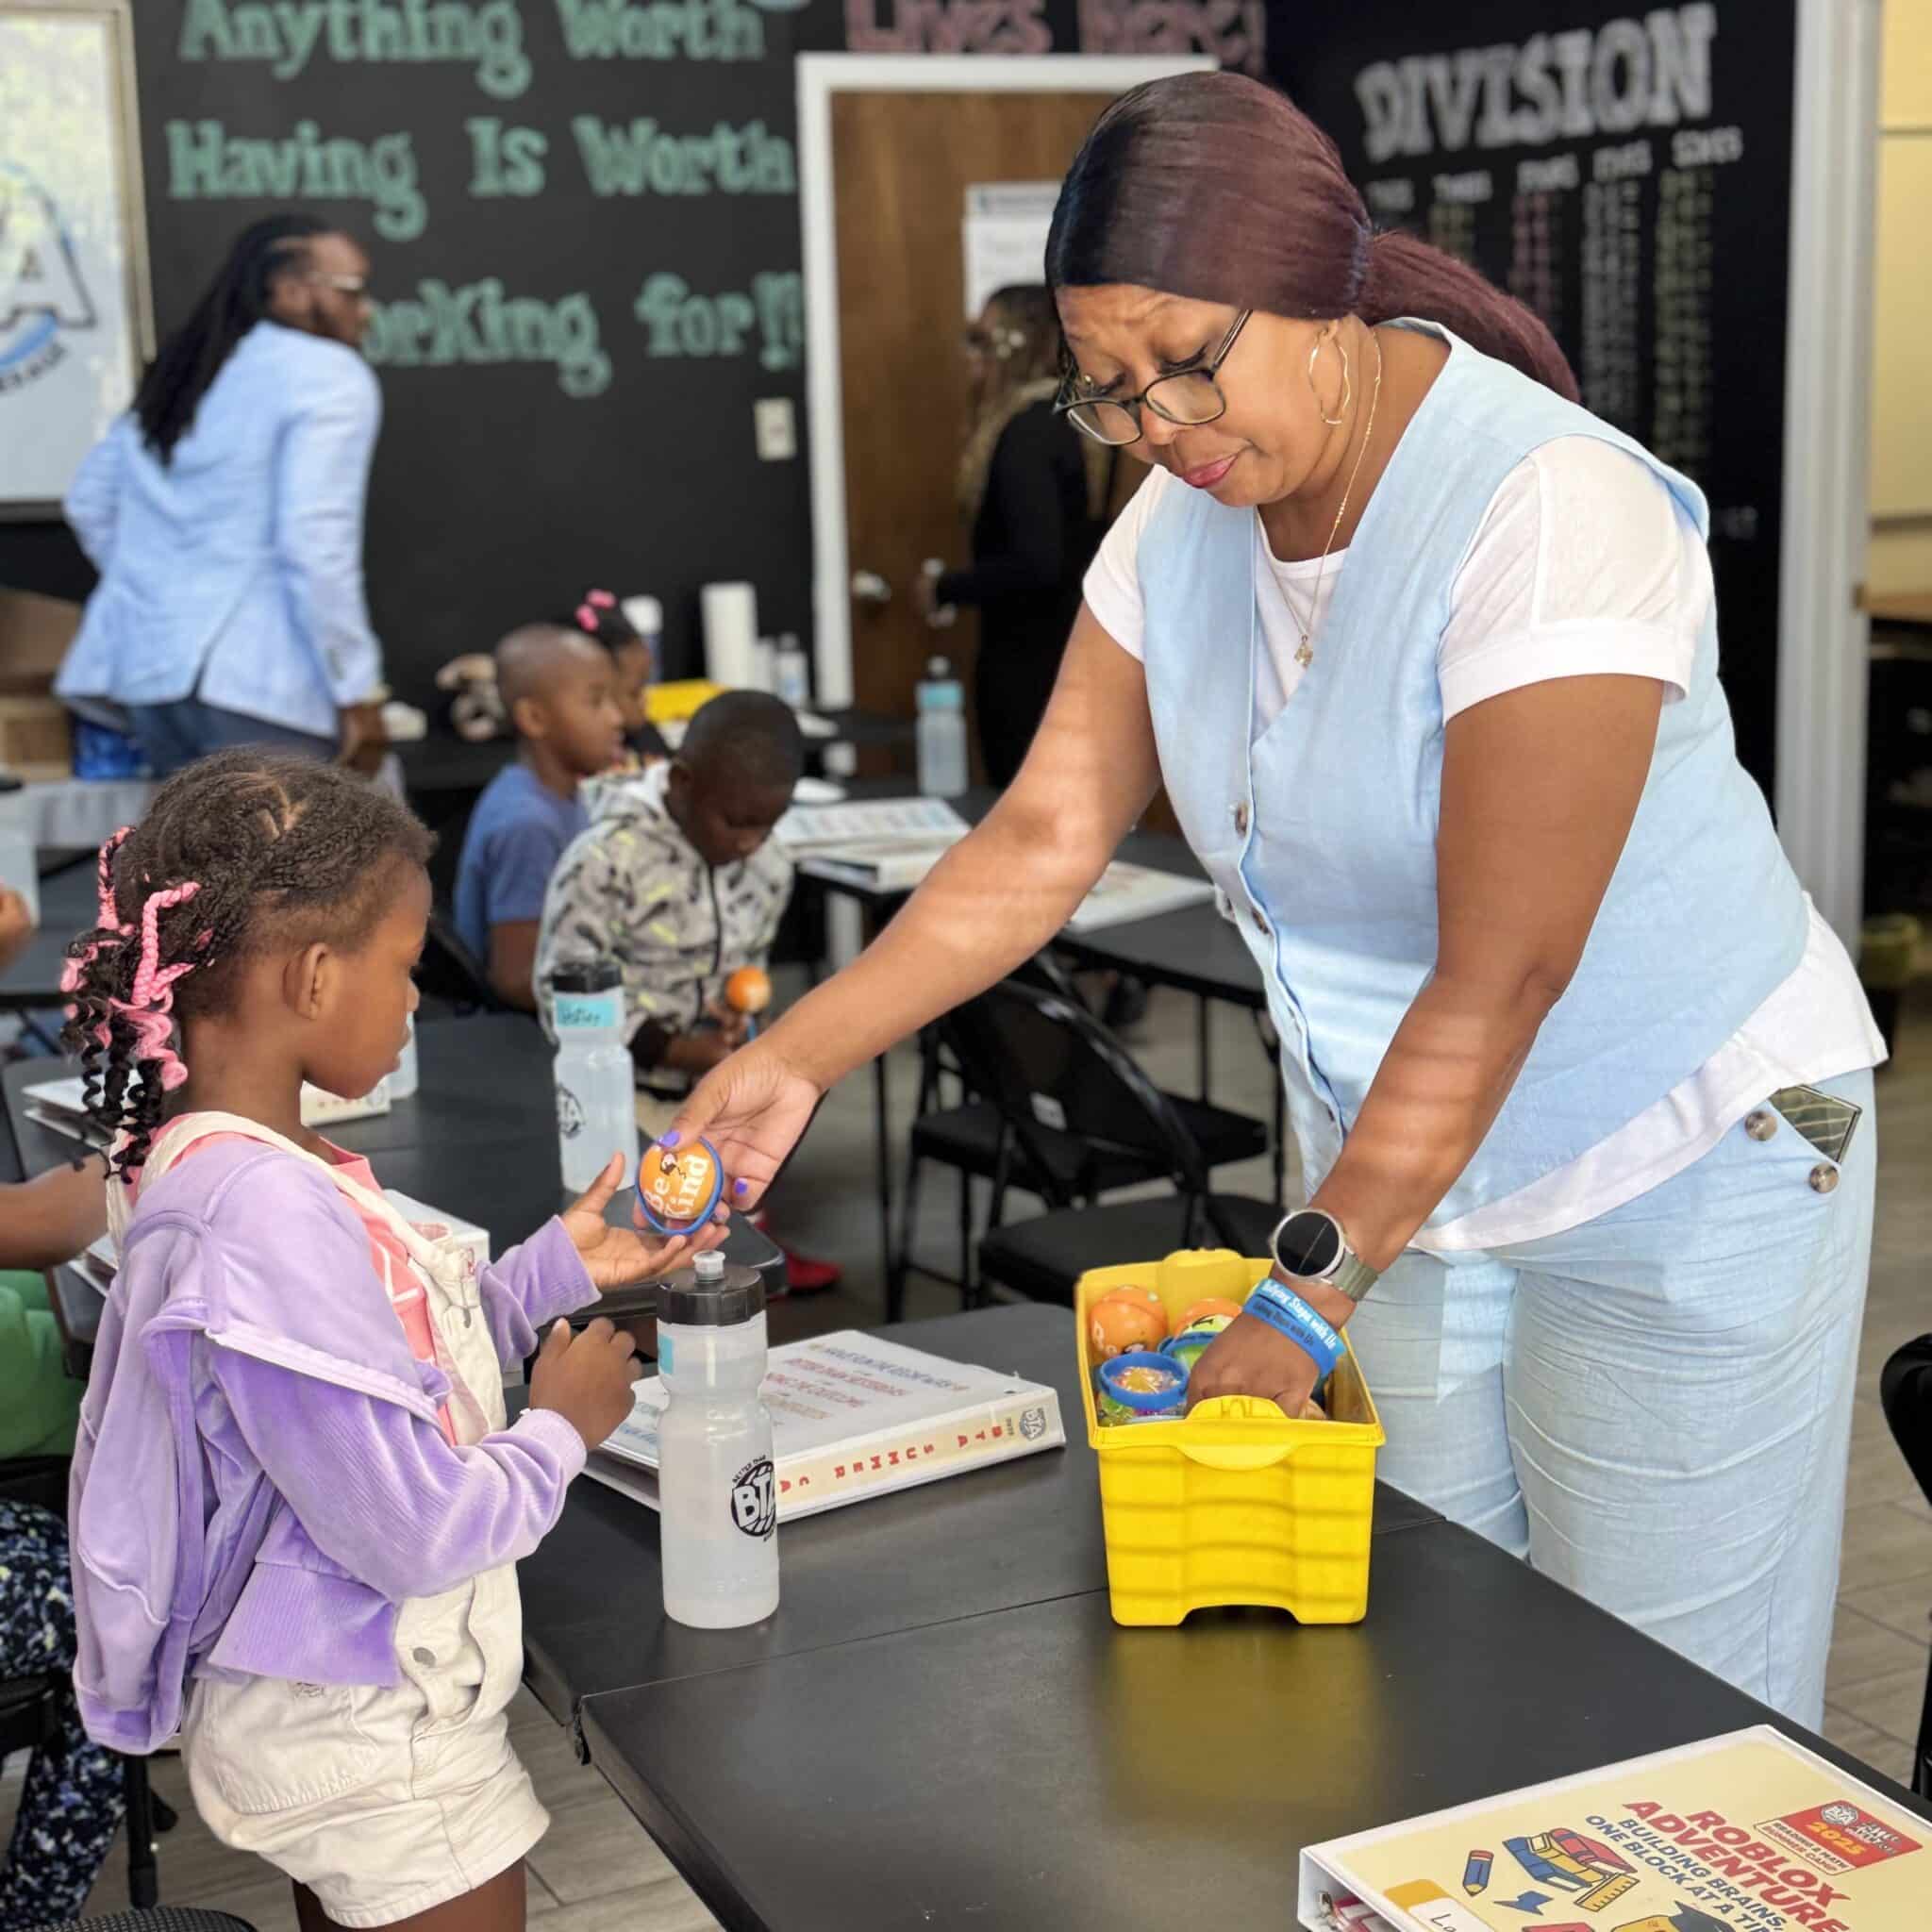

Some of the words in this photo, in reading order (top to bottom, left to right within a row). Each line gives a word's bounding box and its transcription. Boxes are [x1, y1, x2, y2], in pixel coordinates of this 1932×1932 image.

[177, 0, 532, 99] Anything
[555, 0, 765, 60] Worth
[1353, 4, 1717, 163] DIVISION
[164, 119, 428, 242] Having
[464, 116, 549, 197] Is
[571, 114, 797, 196] Worth
[779, 1476, 809, 1493] CA
[1586, 1815, 1630, 1841] ONE
[1623, 1841, 1694, 1885] BLOCK
[1685, 1887, 1721, 1901] AT
[1713, 1904, 1735, 1914] A
[1619, 1819, 1711, 1876] BUILDING
[1685, 1810, 1851, 1907] ROBLOX
[1806, 1822, 1867, 1856] 2025
